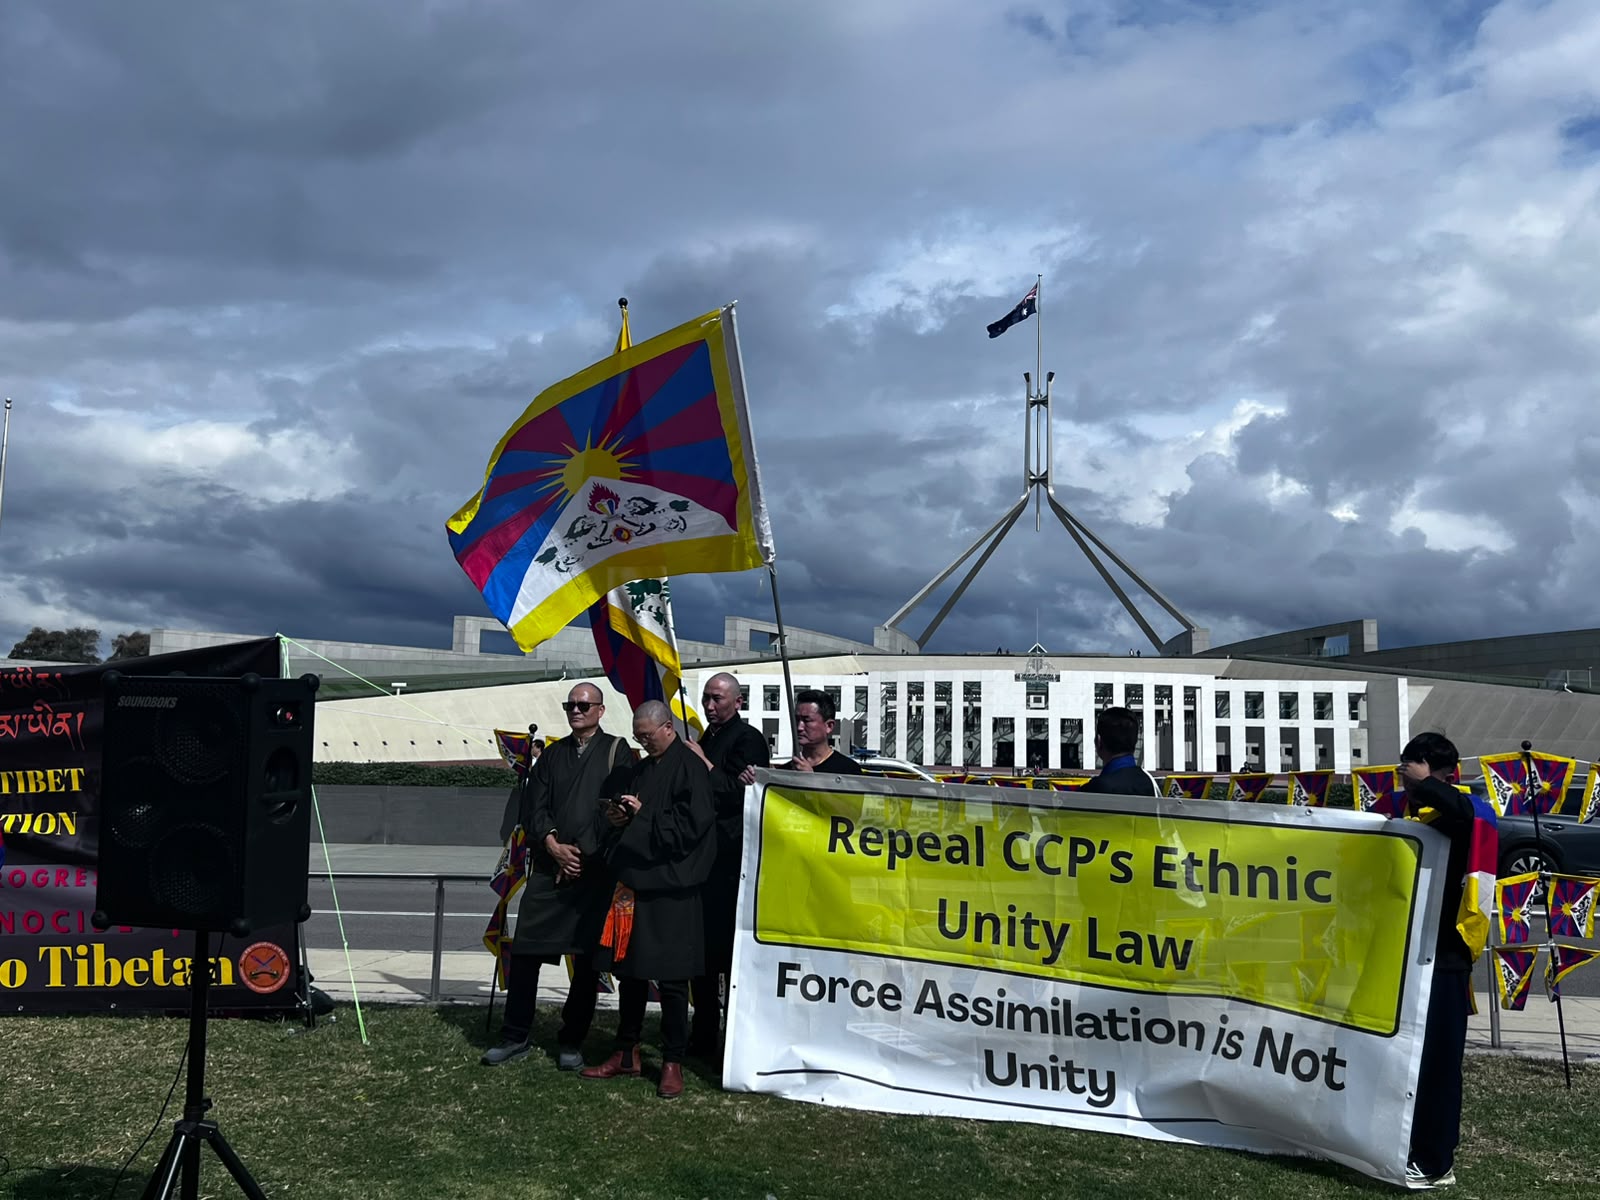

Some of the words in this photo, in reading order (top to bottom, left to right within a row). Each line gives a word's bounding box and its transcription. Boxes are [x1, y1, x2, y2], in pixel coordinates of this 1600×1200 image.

[117, 695, 178, 709] SOUNDBOKS
[0, 768, 85, 794] TIBET
[0, 867, 98, 888] OGRE
[828, 816, 985, 870] Repeal
[1153, 845, 1332, 903] Ethnic
[0, 910, 132, 934] NOCI
[938, 898, 1071, 965] Unity
[1087, 917, 1194, 971] Law
[38, 943, 236, 987] Tibetan
[776, 961, 902, 1011] Force
[913, 979, 1206, 1051] Assimilation
[1212, 1014, 1245, 1060] is
[1253, 1026, 1347, 1091] Not
[984, 1048, 1116, 1108] Unity
